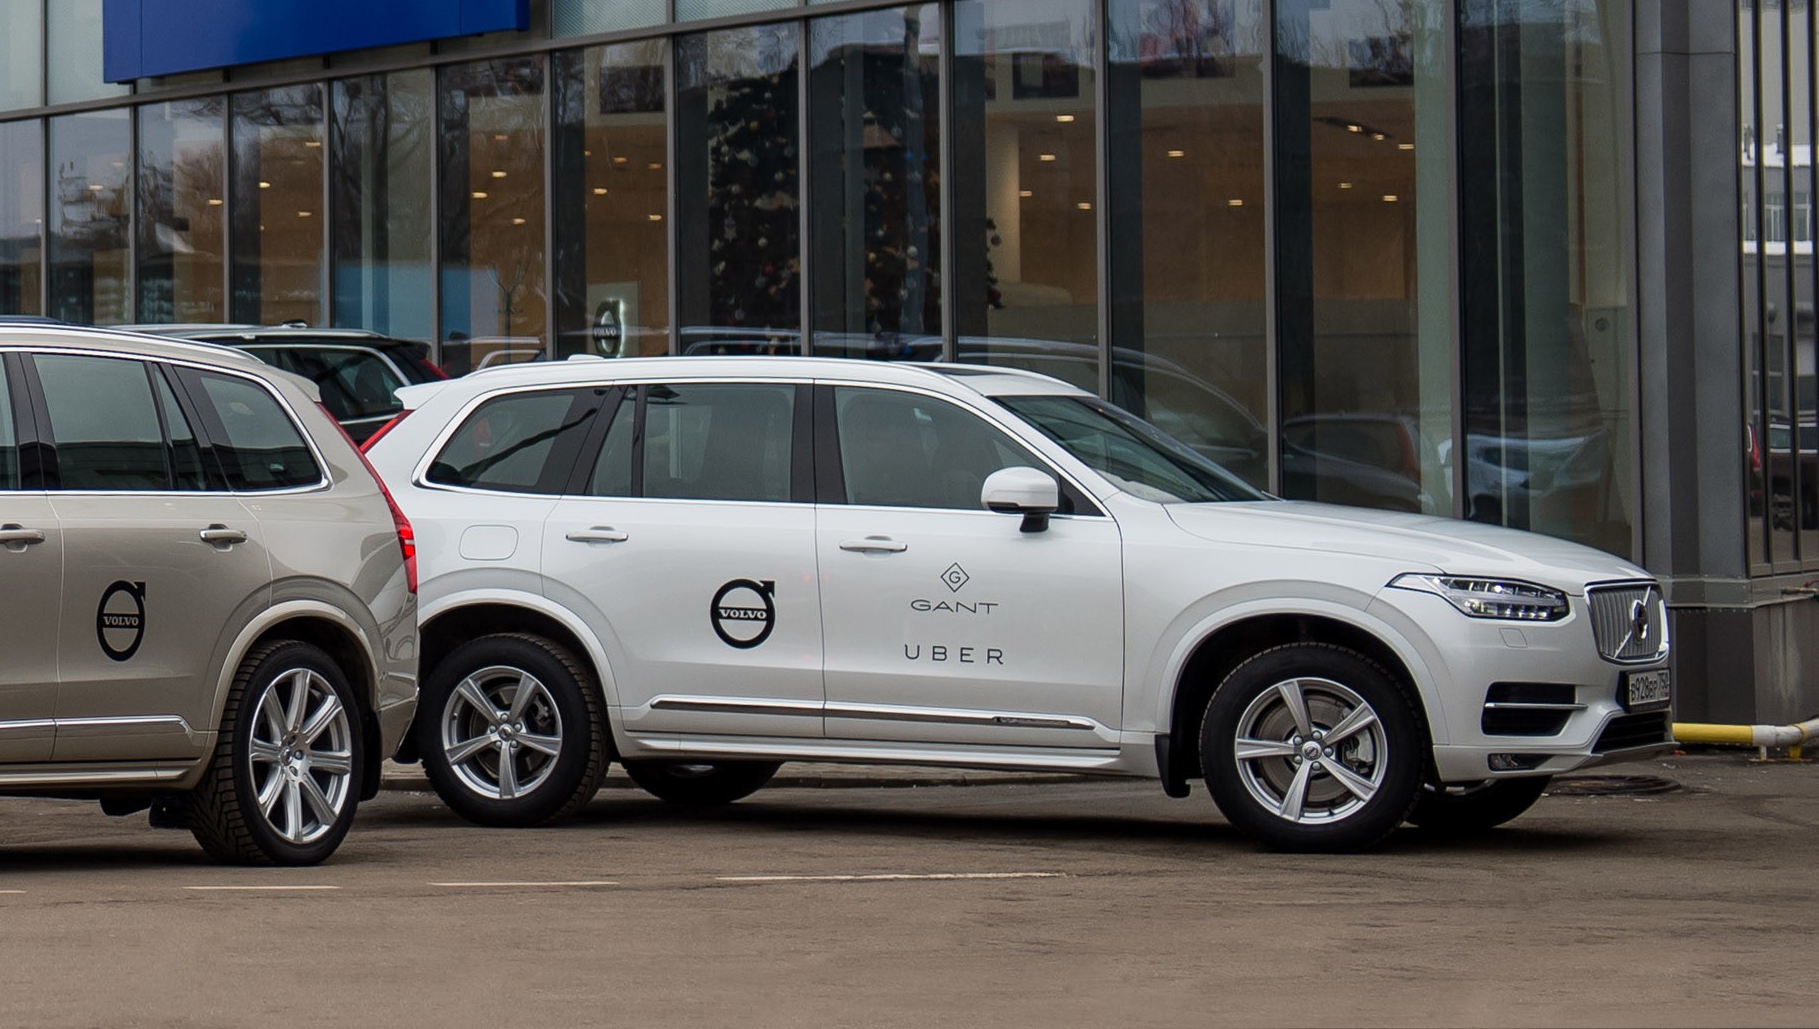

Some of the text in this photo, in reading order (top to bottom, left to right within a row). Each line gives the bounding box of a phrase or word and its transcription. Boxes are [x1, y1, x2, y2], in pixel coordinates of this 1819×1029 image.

[910, 599, 999, 614] GANT
[719, 608, 767, 619] VOLVO
[103, 616, 139, 626] VOLVO
[904, 644, 1004, 665] UBER
